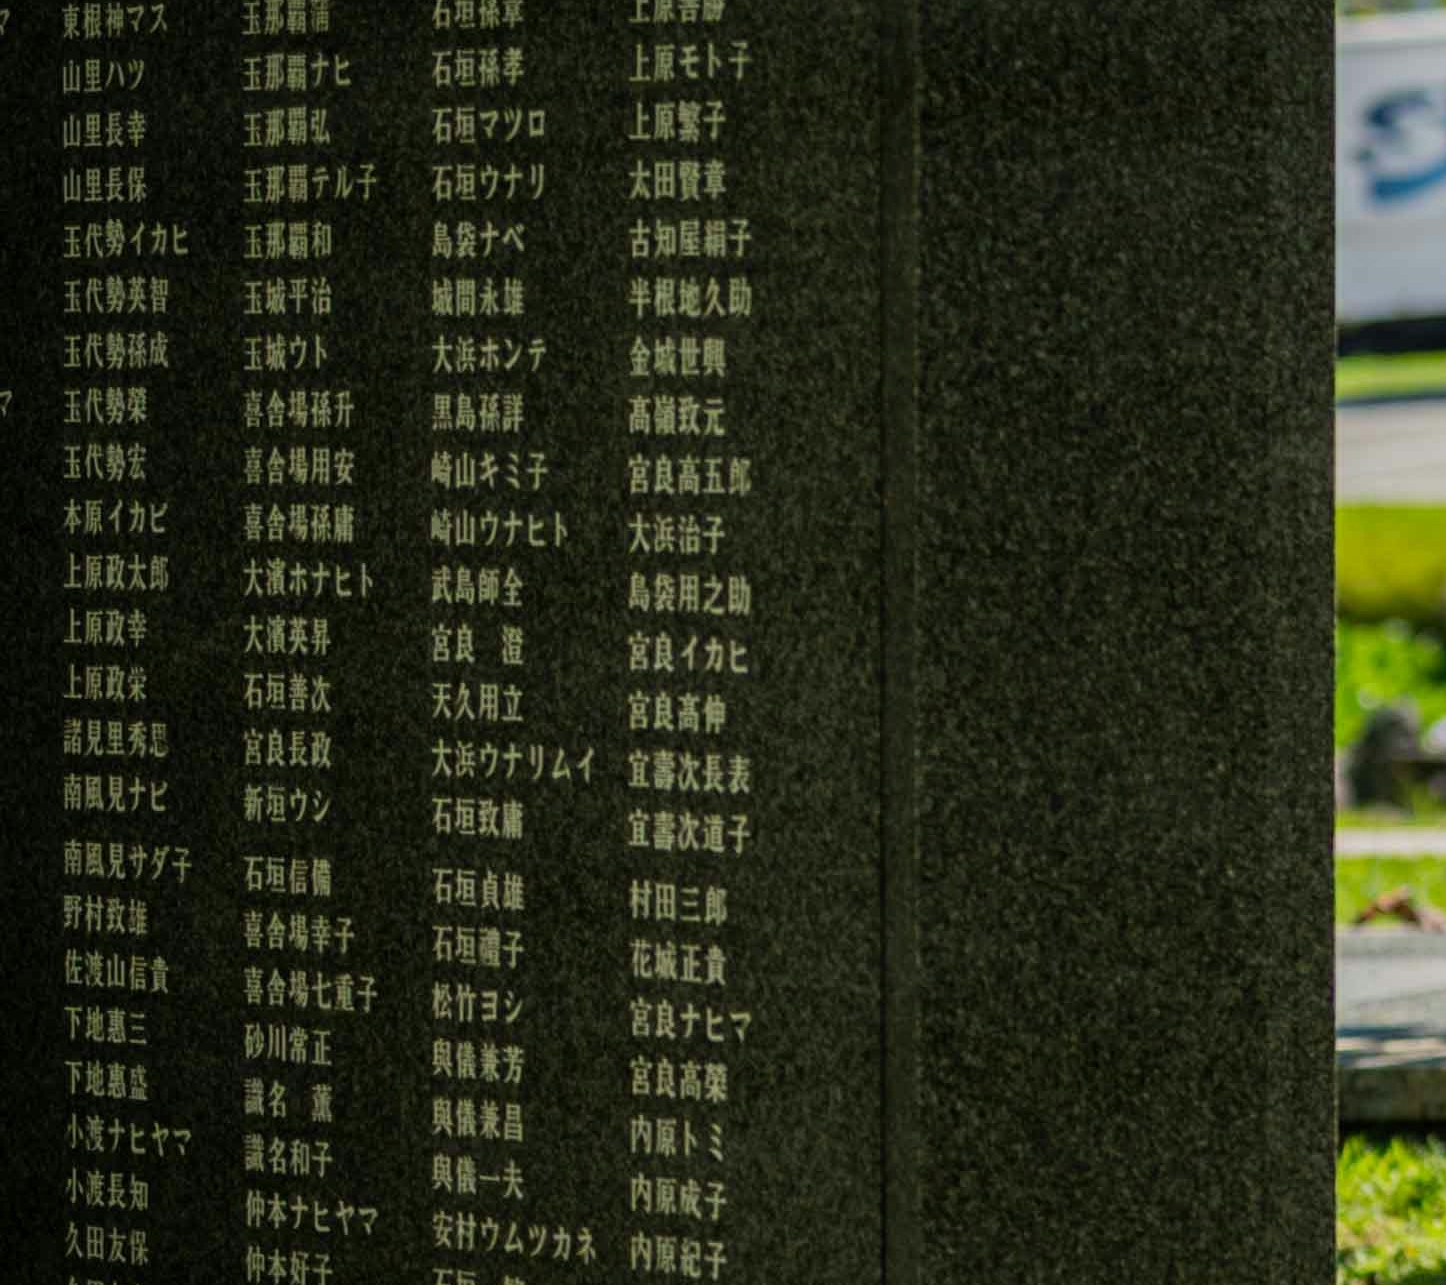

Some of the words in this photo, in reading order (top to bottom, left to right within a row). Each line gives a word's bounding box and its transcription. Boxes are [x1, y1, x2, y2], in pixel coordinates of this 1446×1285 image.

[61, 57, 146, 95] 山里ハツ
[628, 39, 753, 83] 上原モト子
[61, 108, 147, 149] 山里長幸
[62, 165, 148, 204] 山里長保
[431, 162, 546, 202] 石垣ウナリ
[628, 158, 727, 201] 太田賢章
[63, 275, 170, 314] 玉代勢英智
[243, 275, 333, 316] 玉城平治
[430, 276, 525, 317] 城間永雄
[62, 330, 170, 370] 玉代勢孫成
[243, 332, 329, 372] 玉城ウト
[62, 441, 148, 482] 玉代勢宏
[429, 449, 550, 492] 崎山キミ子
[627, 512, 727, 555] 大浜治子
[62, 551, 170, 592] 上原政太郎
[627, 570, 753, 616] 島袋用之助
[62, 607, 148, 648] 上原政幸
[243, 672, 333, 713] 石垣善次
[431, 681, 524, 723] 天久用立
[242, 727, 333, 769] 宮良長政
[242, 782, 331, 824] 新垣ウシ
[628, 878, 729, 927] 村田三郎
[629, 937, 728, 987] 花城正貴
[431, 981, 524, 1025] 松竹ヨシ
[243, 1022, 333, 1067] 砂川常正
[243, 1133, 334, 1179] 識名和子
[629, 1113, 725, 1163] 内原トミ
[431, 1152, 525, 1201] 與儀一夫
[65, 1220, 150, 1266] 久田友保
